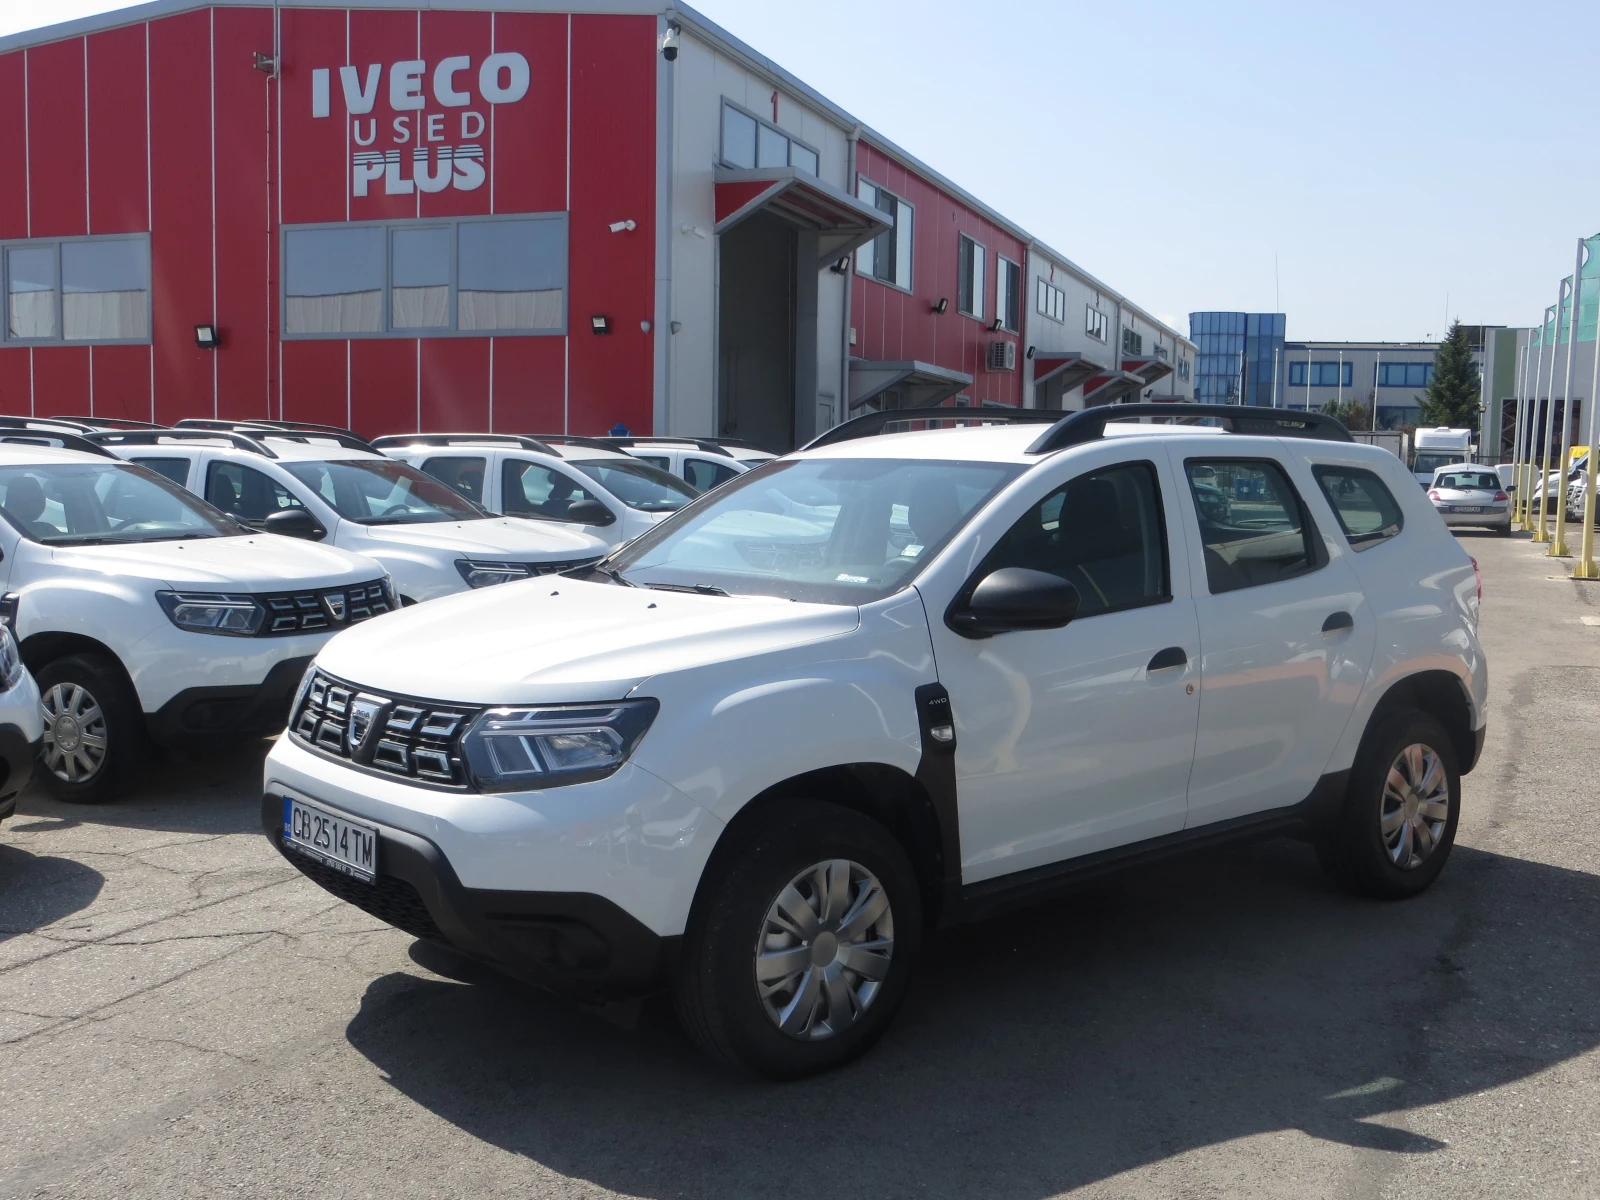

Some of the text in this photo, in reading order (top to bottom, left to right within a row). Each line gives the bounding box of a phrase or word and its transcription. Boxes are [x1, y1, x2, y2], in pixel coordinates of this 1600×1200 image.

[312, 52, 530, 118] IVECO
[770, 91, 778, 124] 1
[353, 111, 485, 146] USED
[353, 144, 486, 197] PLUS
[928, 697, 947, 705] 4WD
